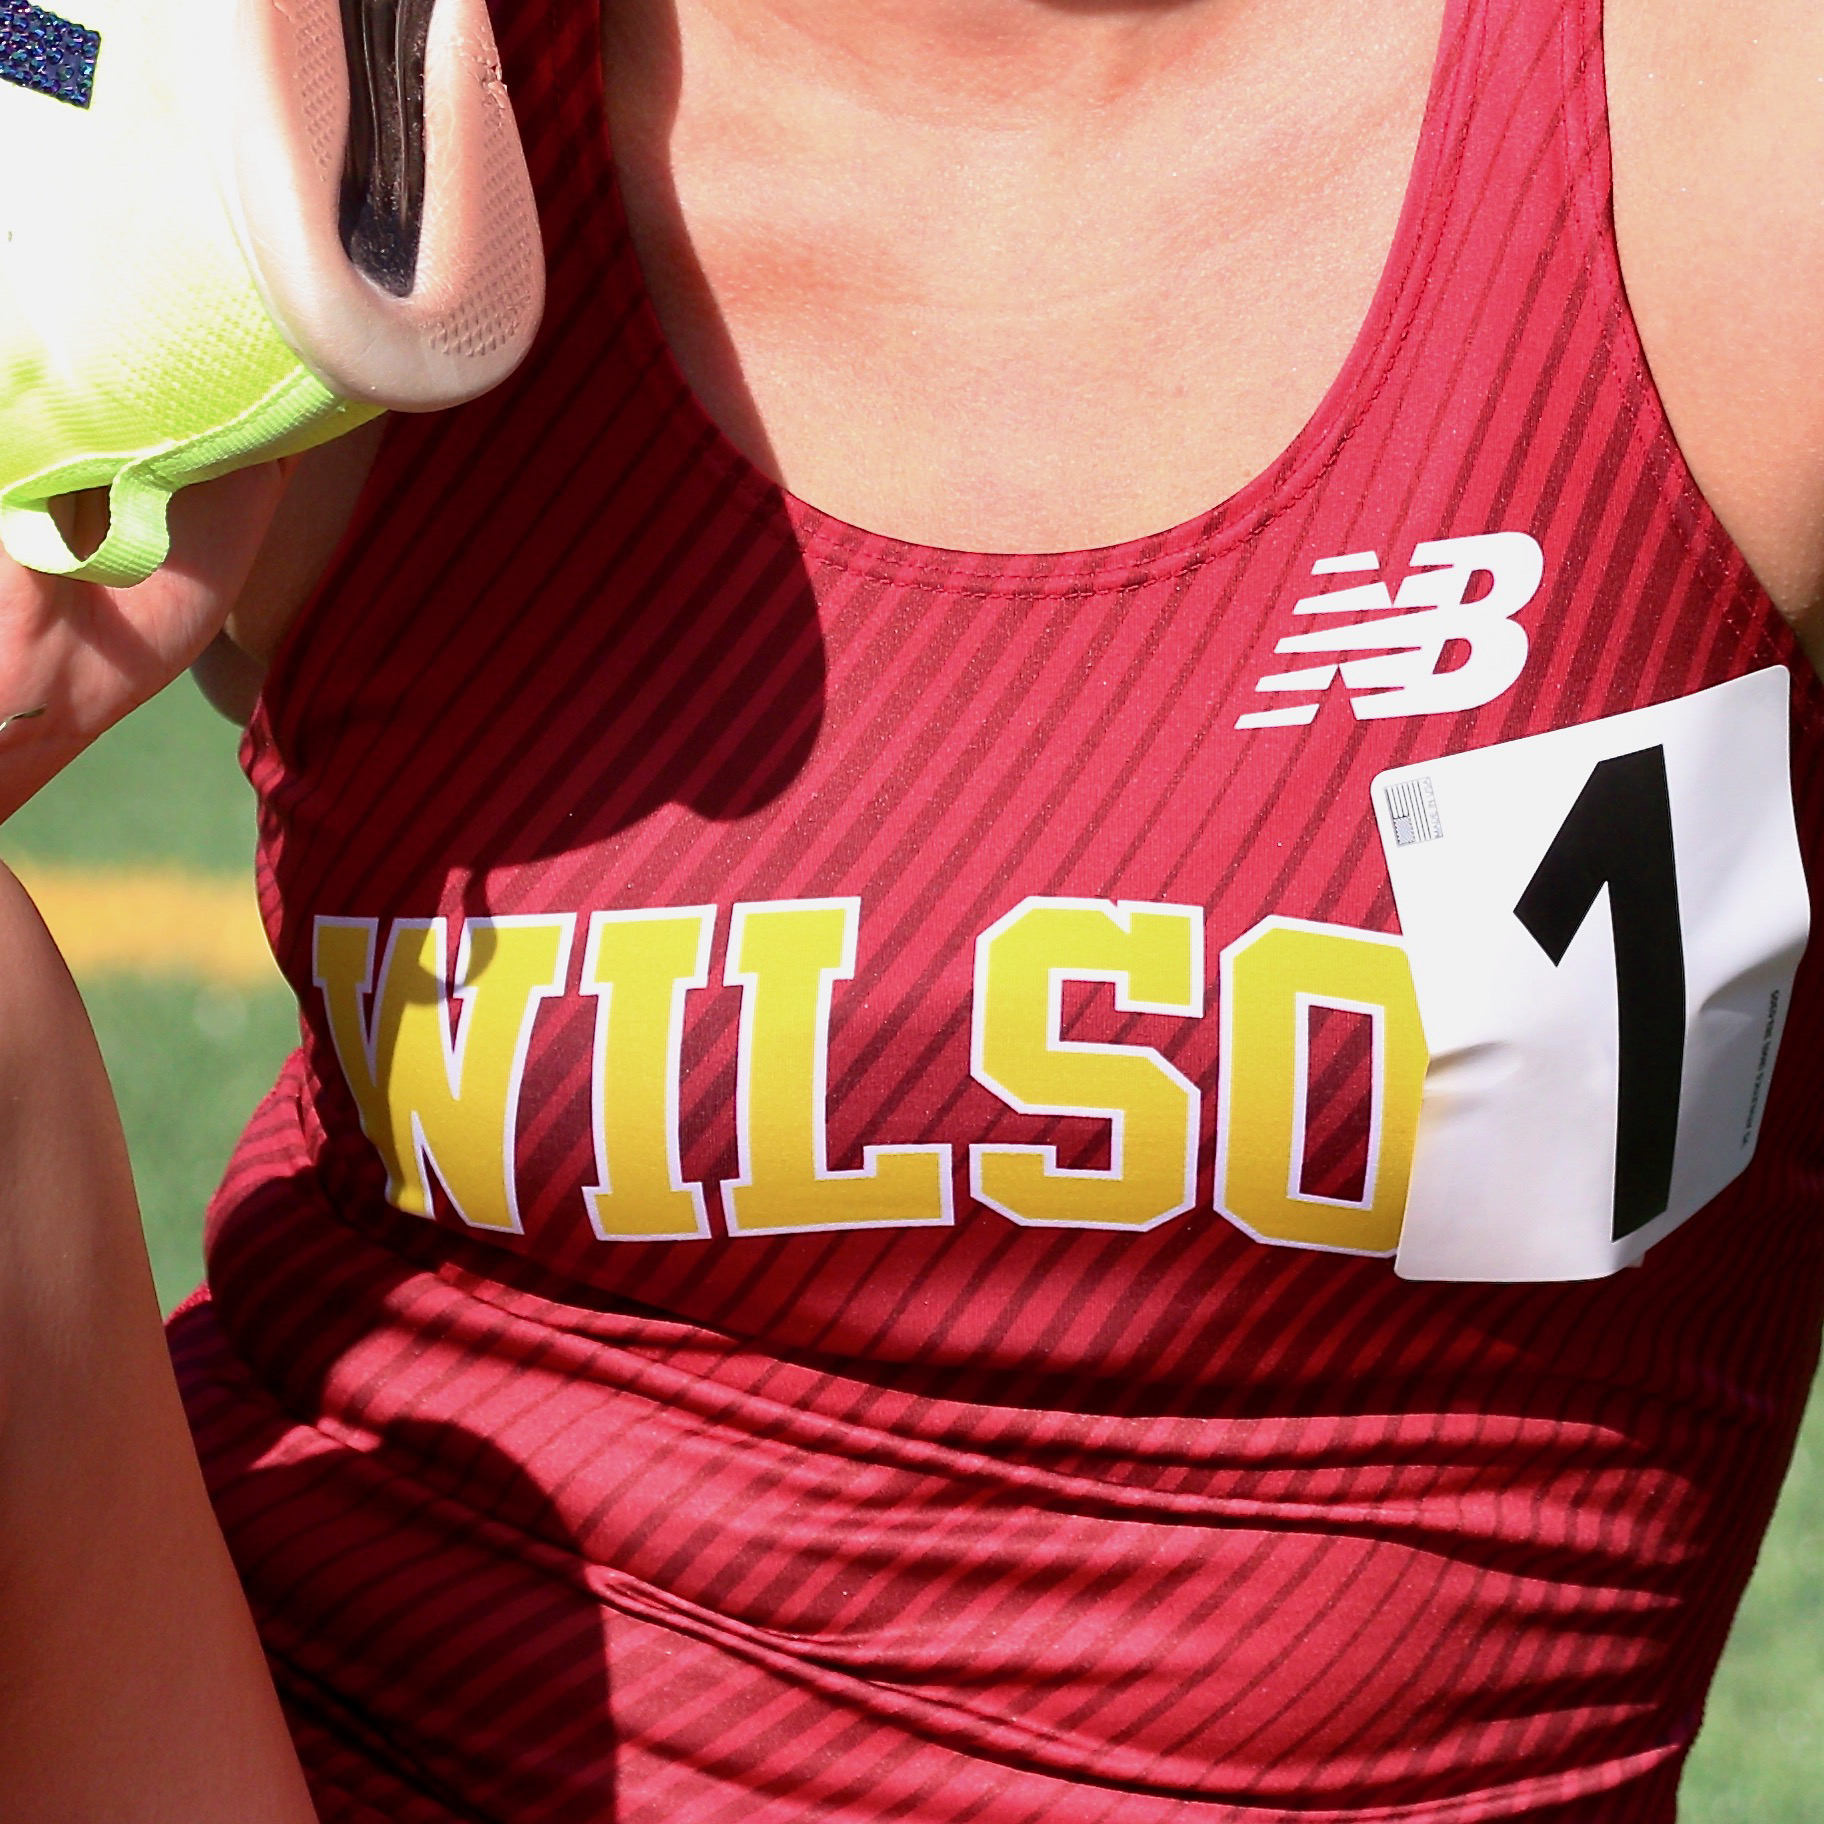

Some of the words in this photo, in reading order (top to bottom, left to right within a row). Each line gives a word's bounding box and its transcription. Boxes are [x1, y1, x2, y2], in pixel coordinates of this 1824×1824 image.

[1234, 531, 1544, 729] NB
[312, 895, 1429, 1260] WILSO
[1513, 743, 1686, 1241] 1
